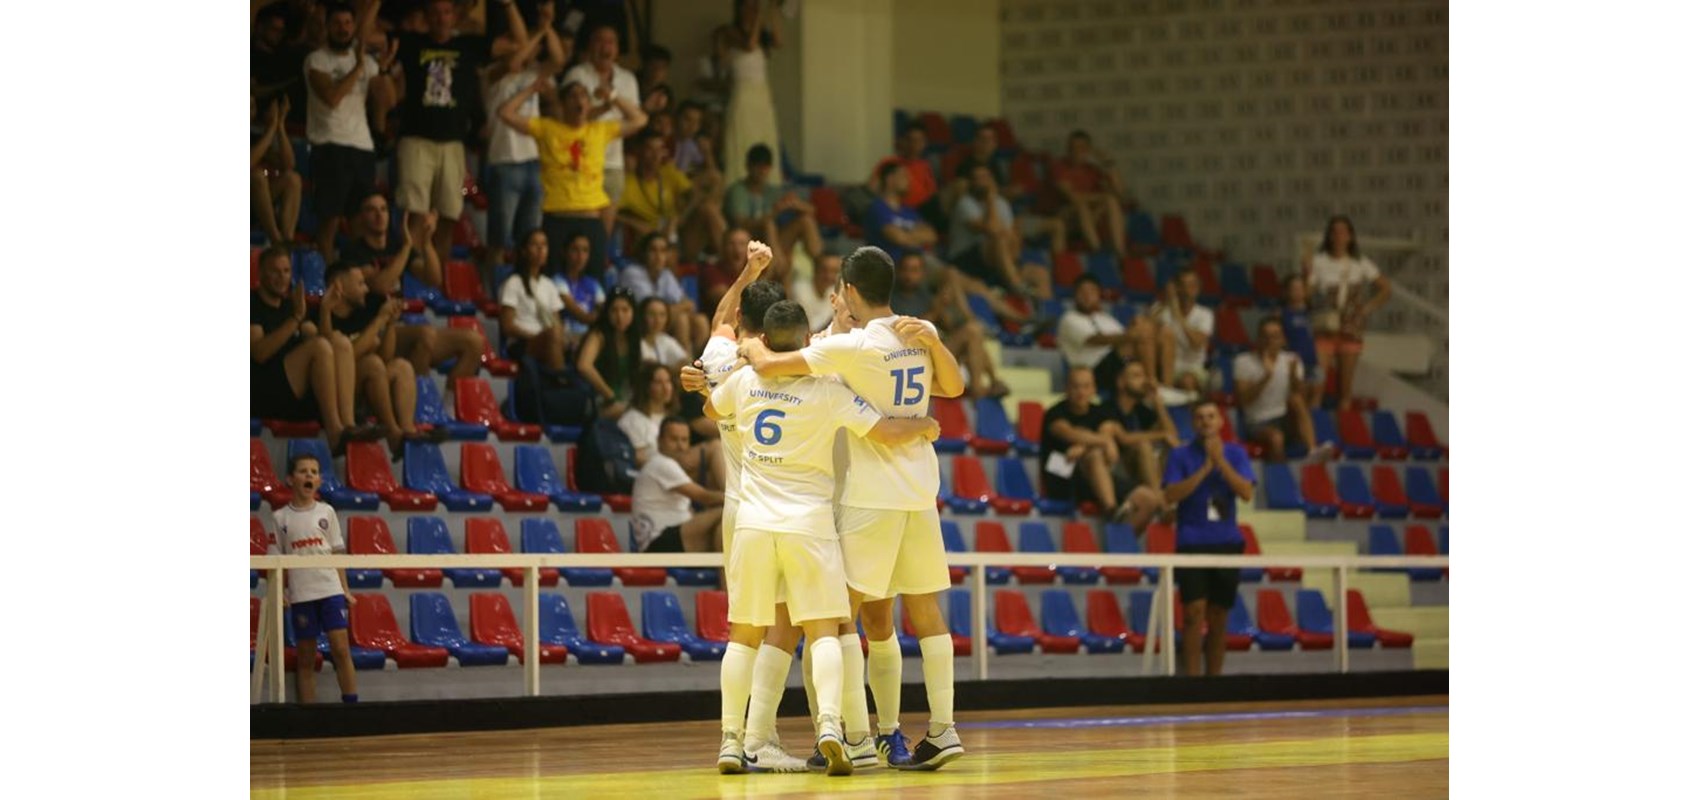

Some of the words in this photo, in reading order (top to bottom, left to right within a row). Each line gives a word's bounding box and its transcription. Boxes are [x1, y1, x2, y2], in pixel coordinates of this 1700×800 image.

[883, 348, 927, 362] UNIVERSITY
[890, 366, 925, 406] 15
[749, 390, 803, 406] UNIVERSITY
[754, 409, 787, 446] 6
[758, 455, 784, 464] SPLIT
